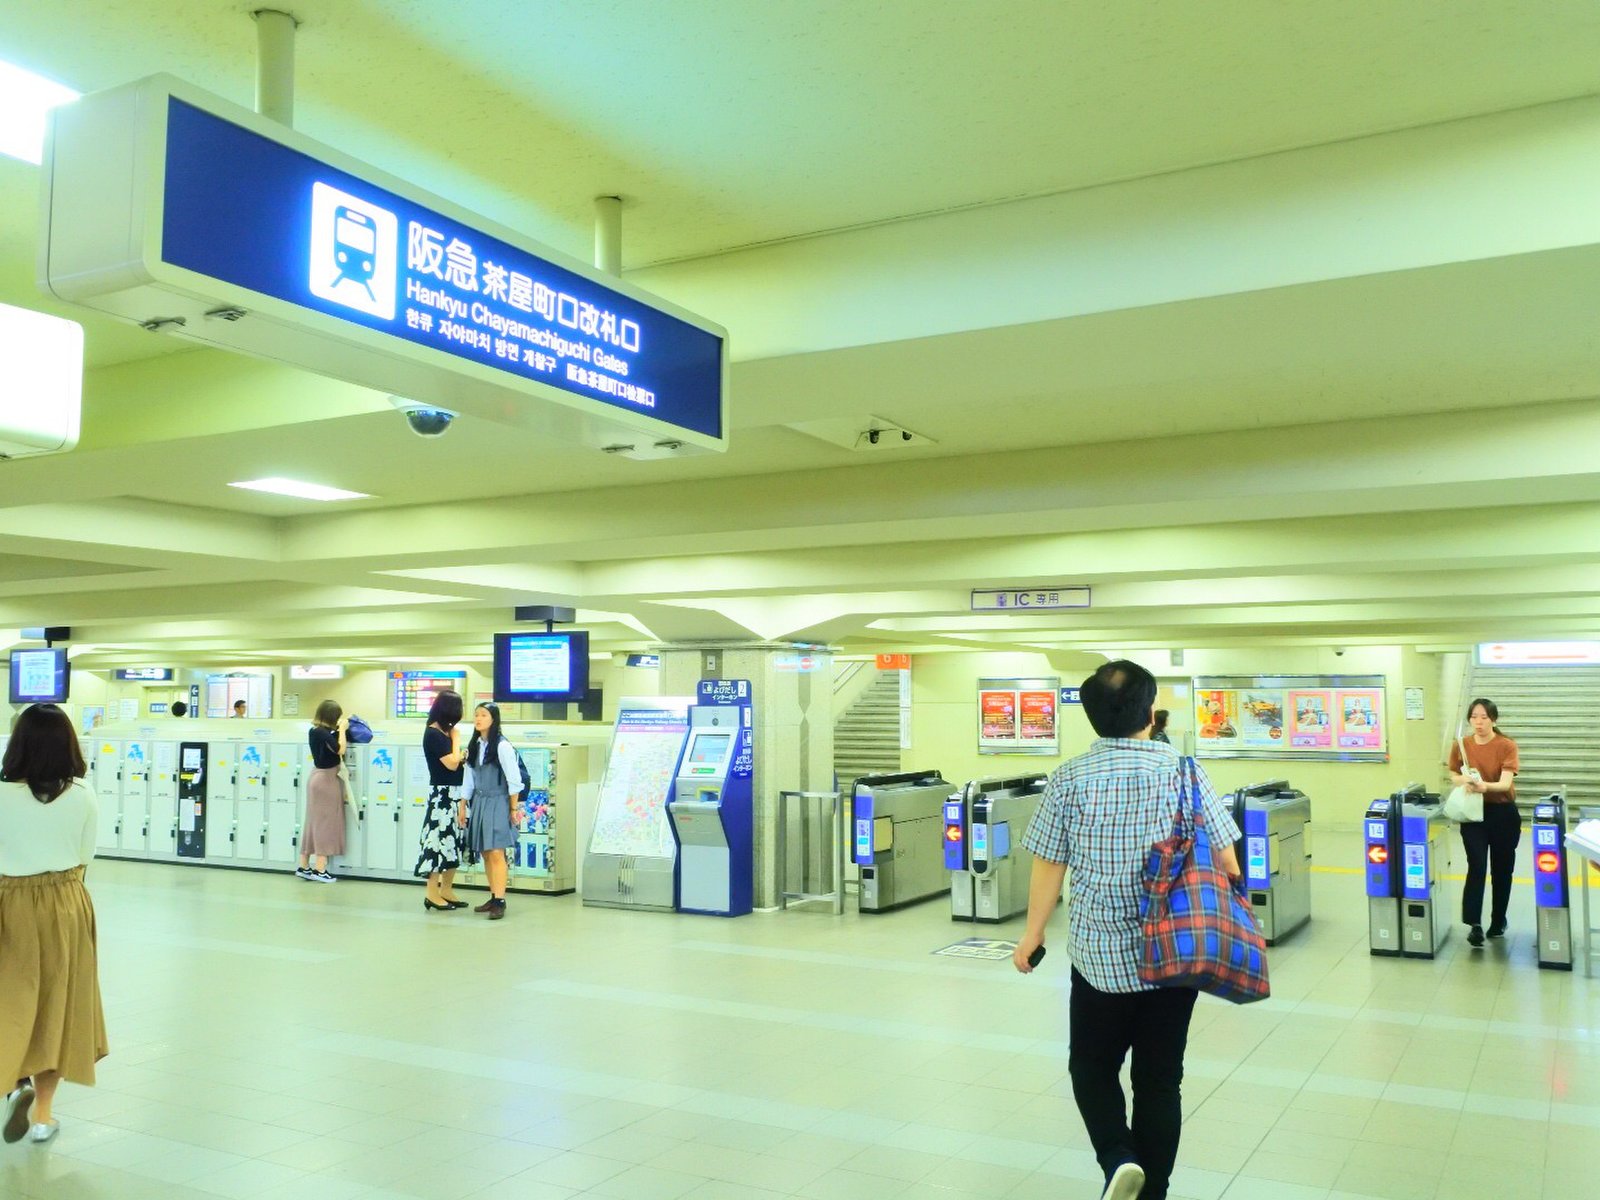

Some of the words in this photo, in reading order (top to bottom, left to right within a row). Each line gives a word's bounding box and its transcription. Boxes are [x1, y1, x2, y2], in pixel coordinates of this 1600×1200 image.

[406, 277, 468, 319] Hankyu
[471, 302, 591, 363] Chayamachiguchi
[593, 347, 629, 377] Gates
[1014, 592, 1031, 607] IC
[1370, 825, 1384, 837] 14
[1540, 831, 1554, 844] 15
